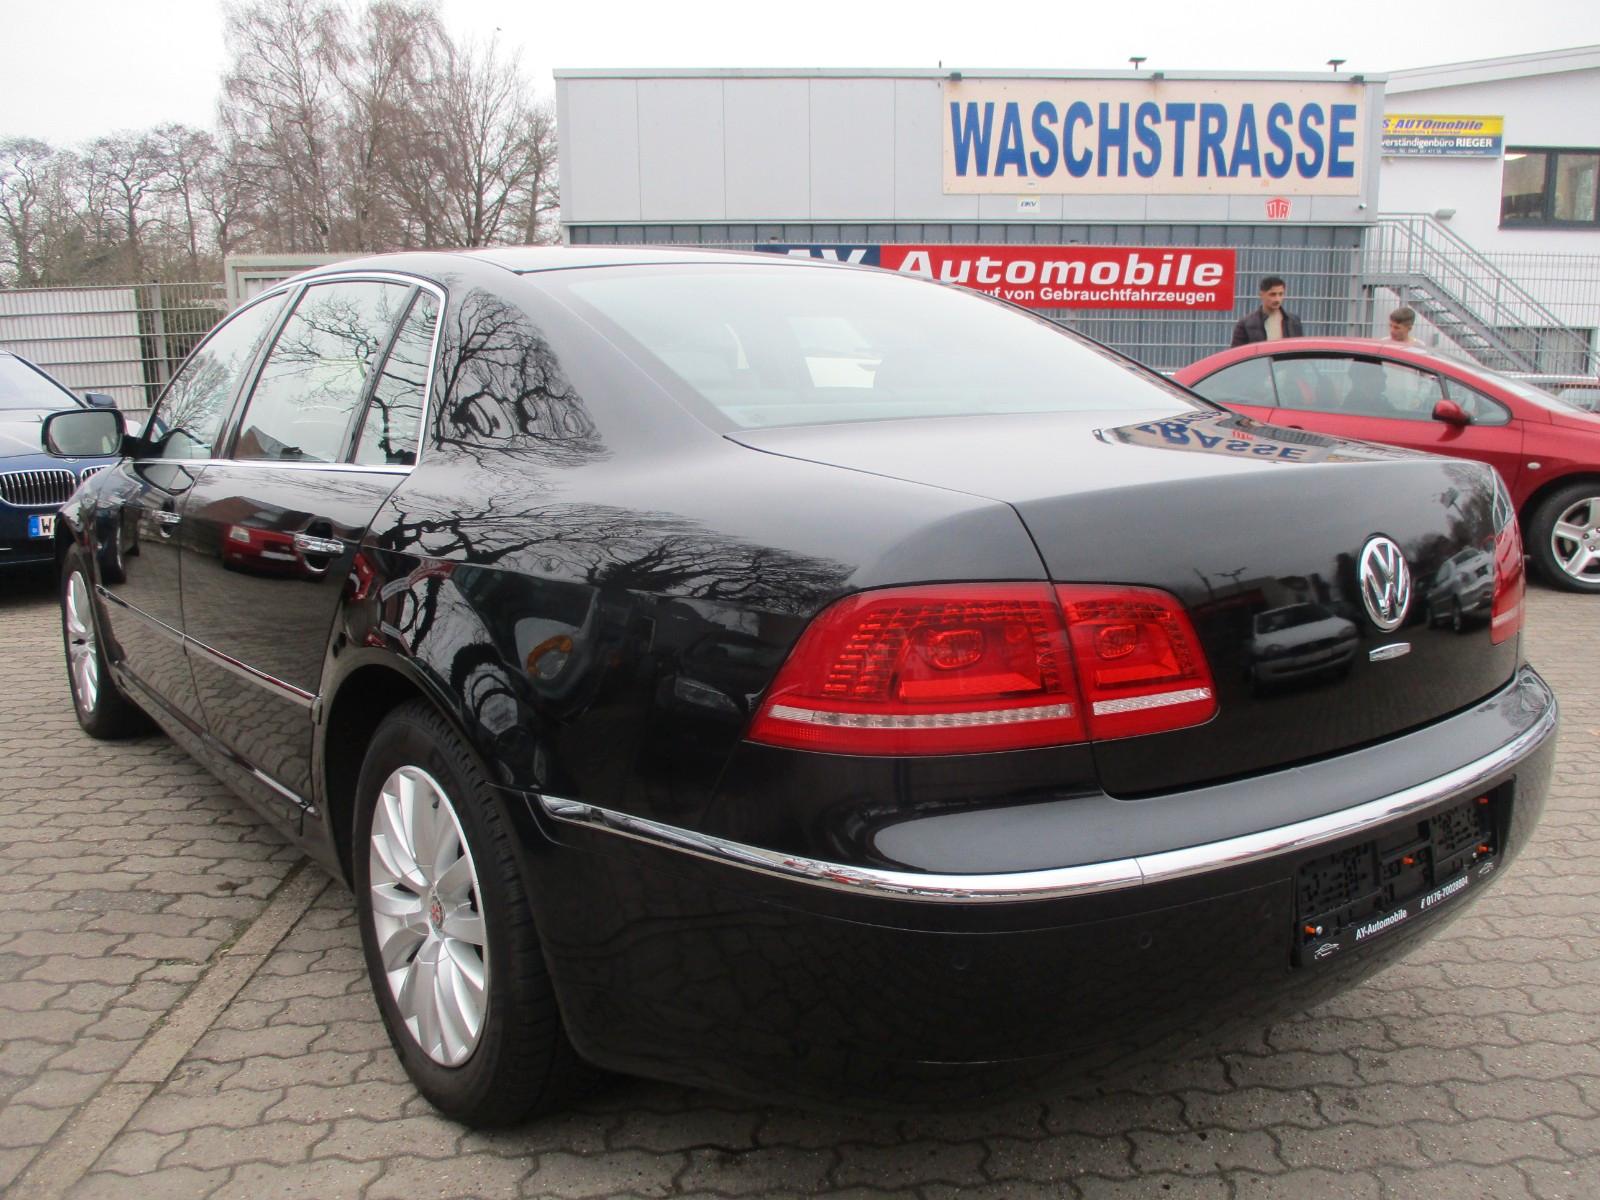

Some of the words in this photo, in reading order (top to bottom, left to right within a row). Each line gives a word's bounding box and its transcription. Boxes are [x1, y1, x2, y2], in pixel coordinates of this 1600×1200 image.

[950, 101, 1357, 178] WASCHSTRASSE
[1455, 137, 1492, 148] RIEGER
[898, 250, 1223, 286] Automobile
[1004, 289, 1035, 300] von
[1040, 286, 1216, 304] Gebrauchtfahrzeugen
[1355, 908, 1408, 941] AY-Automobile
